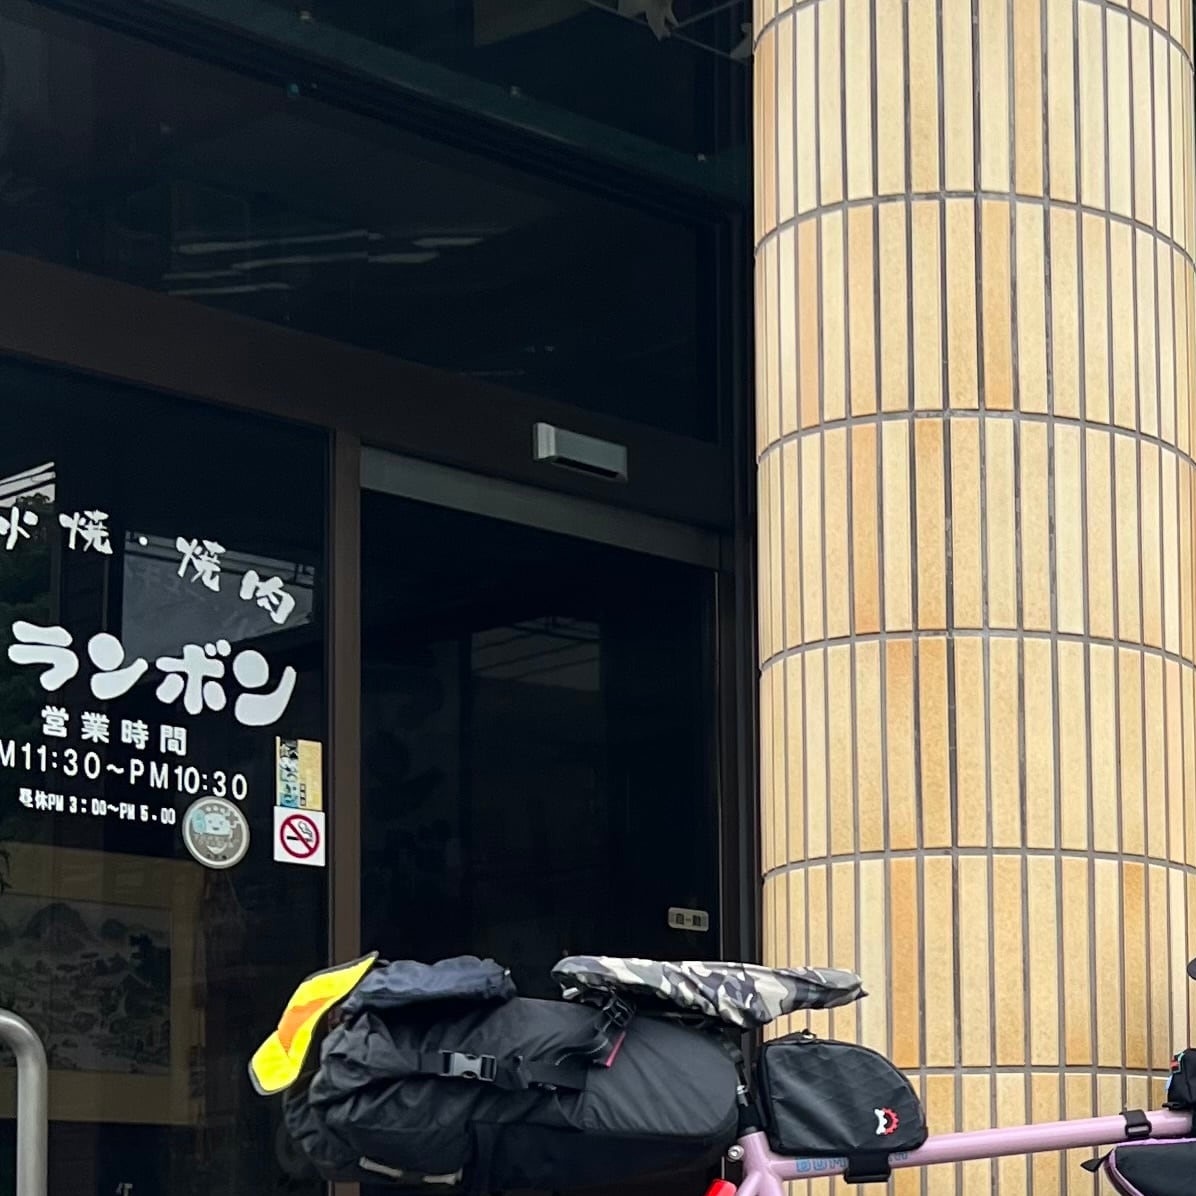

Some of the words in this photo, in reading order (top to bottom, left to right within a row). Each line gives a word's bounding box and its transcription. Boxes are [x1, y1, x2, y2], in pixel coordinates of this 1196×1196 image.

[8, 620, 297, 726] ランボン
[41, 705, 187, 756] 営業時間
